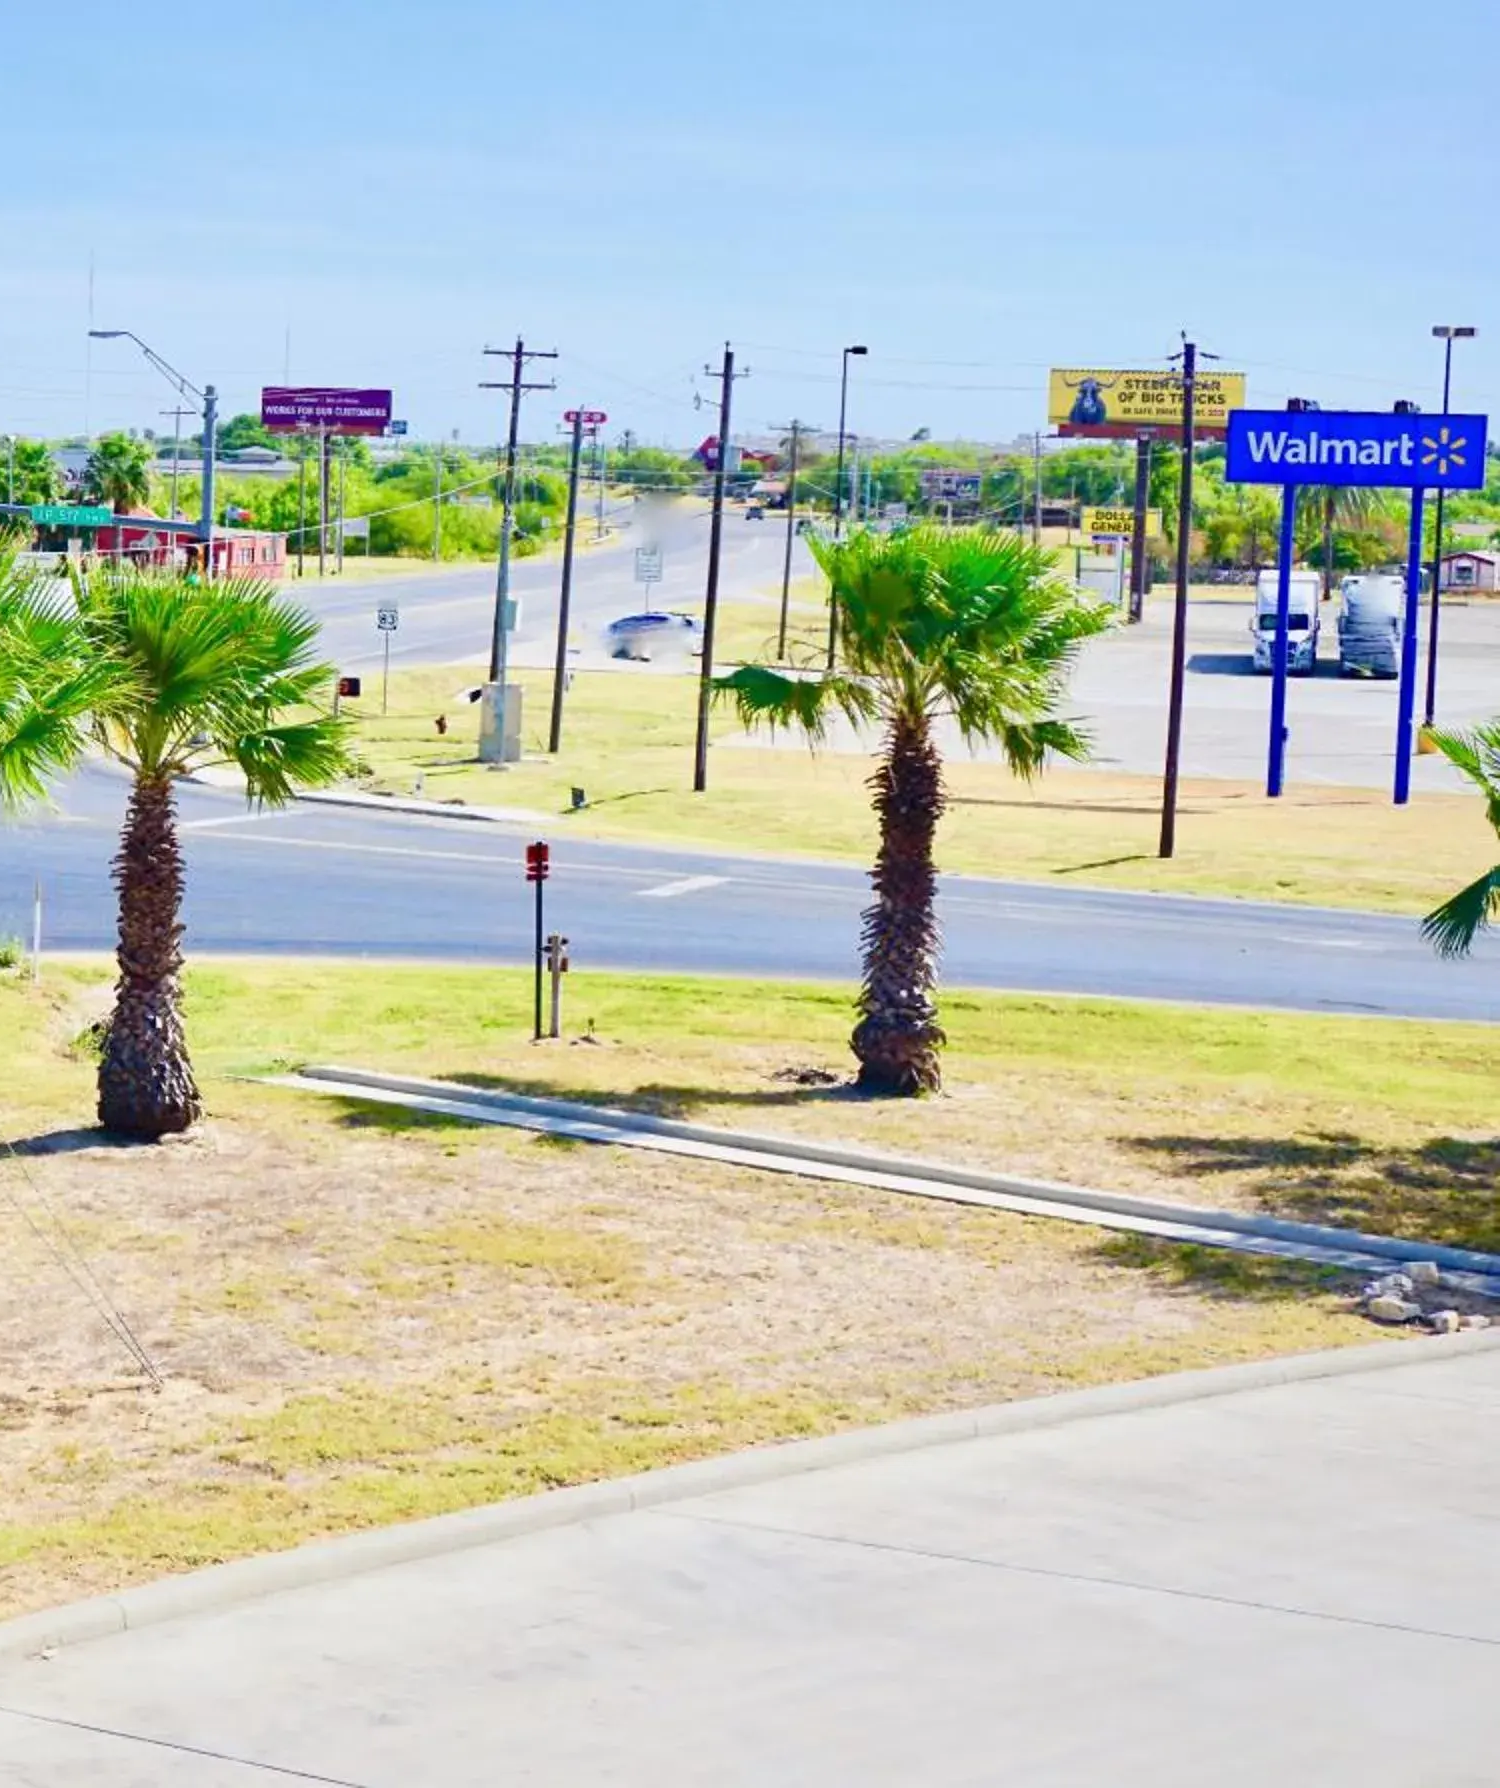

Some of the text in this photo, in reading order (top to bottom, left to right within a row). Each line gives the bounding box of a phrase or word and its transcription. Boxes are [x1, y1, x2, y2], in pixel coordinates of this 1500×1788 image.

[1118, 392, 1136, 403] OF
[1141, 392, 1165, 403] BIG
[297, 406, 314, 415] FOR
[1247, 431, 1415, 466] Walmart
[1095, 510, 1134, 521] DOLLA
[1091, 521, 1134, 532] GENER
